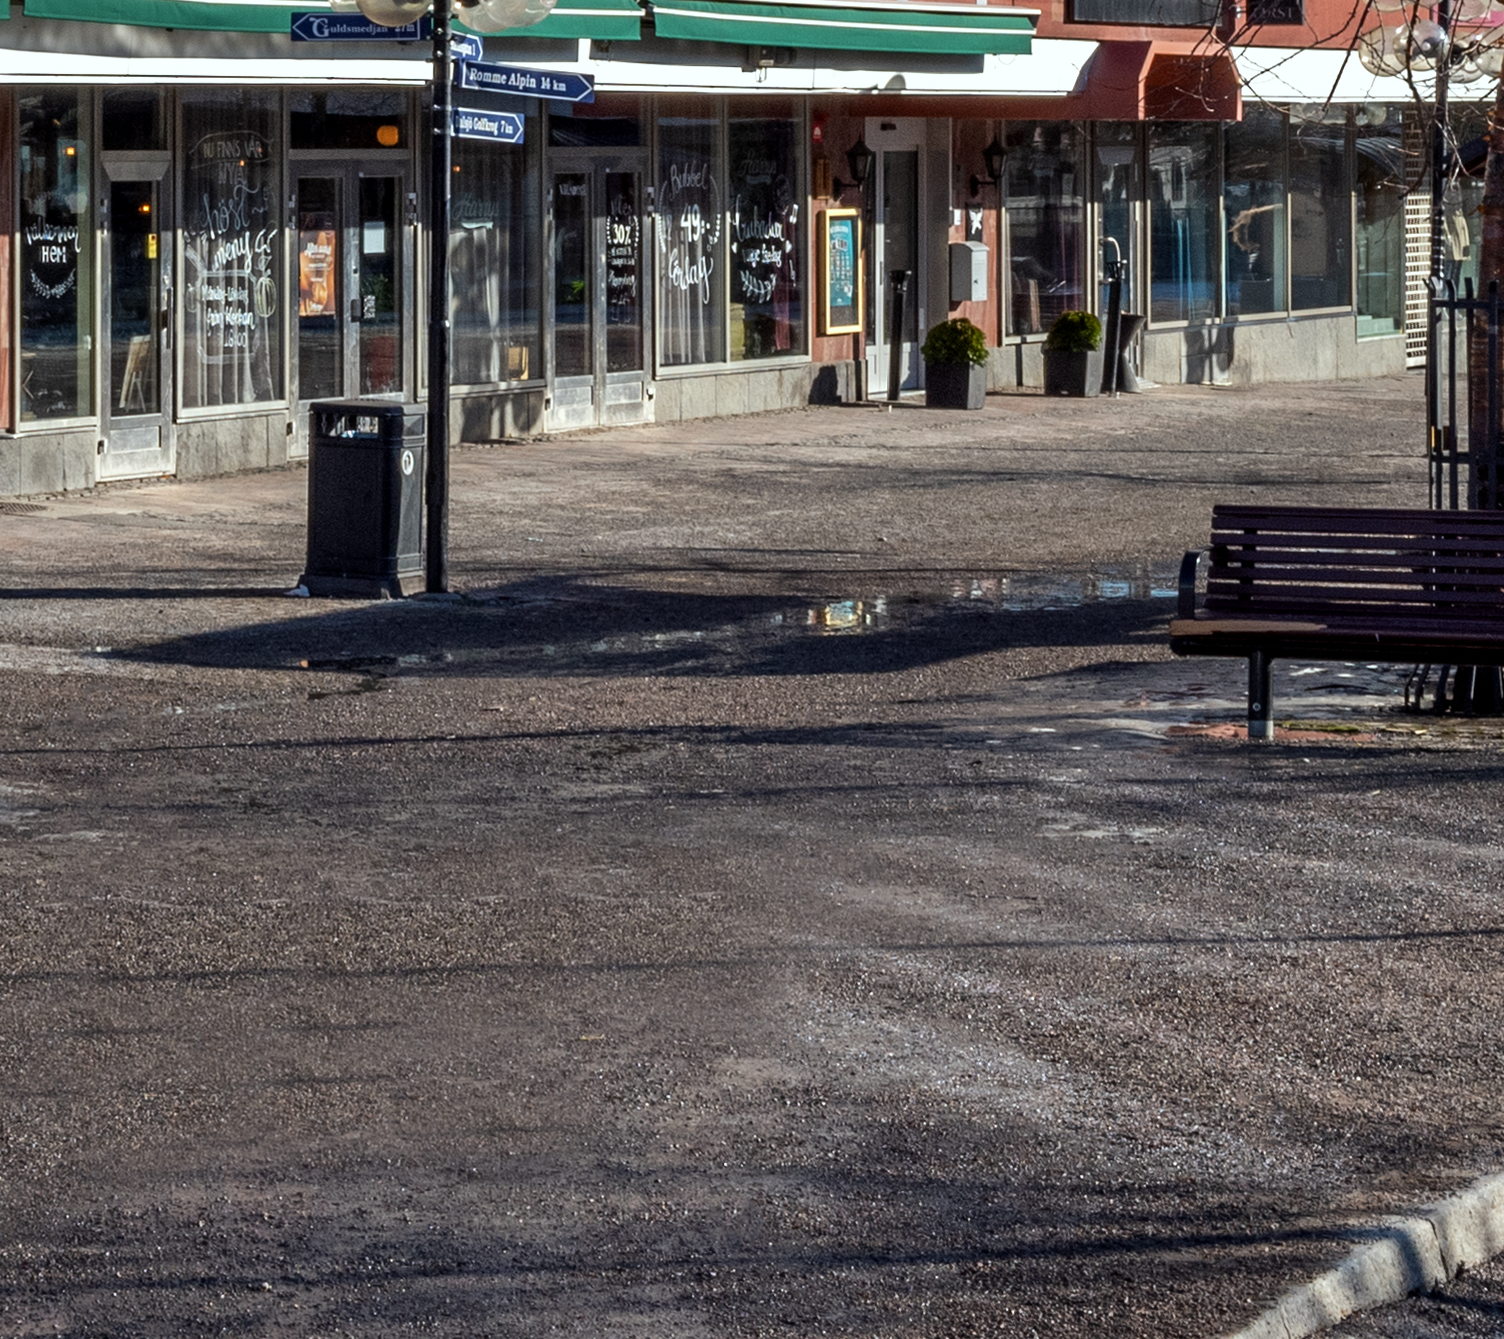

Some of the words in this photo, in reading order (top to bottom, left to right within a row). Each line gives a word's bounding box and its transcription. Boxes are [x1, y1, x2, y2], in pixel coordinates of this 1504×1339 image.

[309, 17, 388, 37] Guldsmedjan
[469, 67, 507, 85] Romme
[508, 74, 536, 90] Alpin
[540, 77, 551, 90] 14
[553, 80, 566, 92] km
